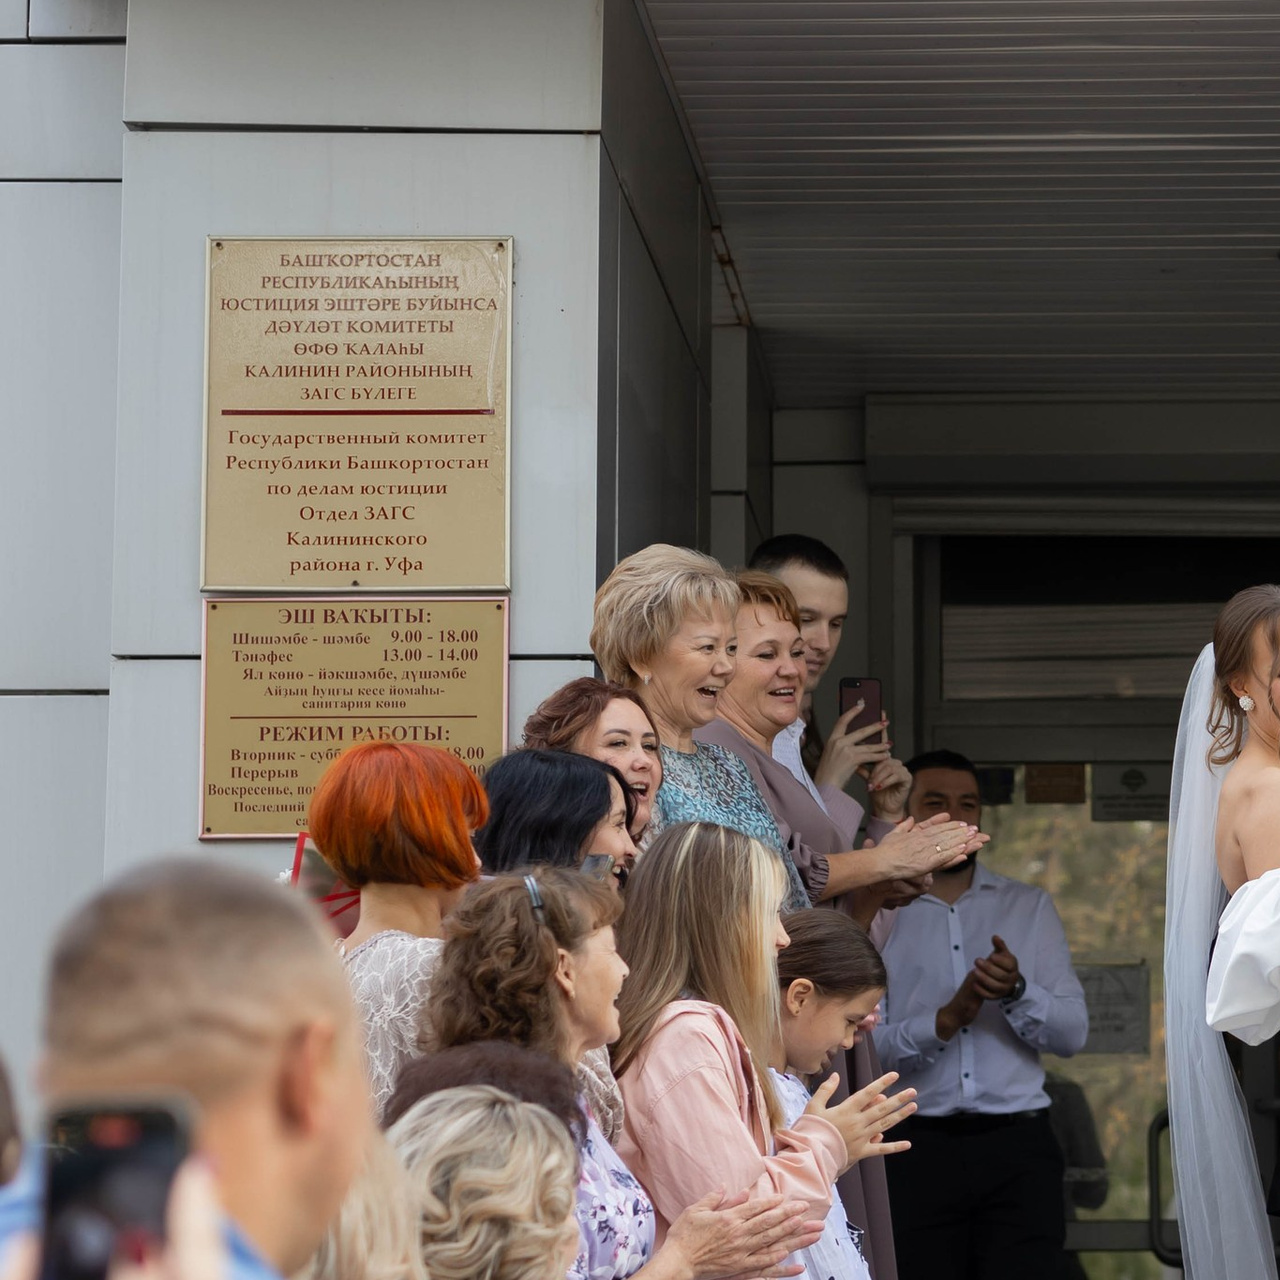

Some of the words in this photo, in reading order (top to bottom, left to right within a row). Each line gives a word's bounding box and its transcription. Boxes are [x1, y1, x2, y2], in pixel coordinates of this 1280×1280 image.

[220, 298, 319, 313] ЮСТИЦИЯ
[324, 298, 401, 311] ЭШТӘРЕ
[406, 295, 497, 311] БУЙЫНСА
[346, 320, 454, 333] КОМИТЕТЫ
[294, 343, 338, 355] ӨФӨ
[245, 365, 340, 377] КАЛИНИН
[346, 362, 473, 378] РАЙОНЫНЫҢ
[300, 388, 345, 400] ЗАГС
[228, 430, 400, 449] Государственный
[406, 433, 487, 445] комитет
[226, 455, 341, 474] Республики
[347, 456, 489, 474] Башкортостан
[267, 485, 291, 495] по
[297, 485, 354, 497] делам
[360, 484, 448, 497] юстиции
[300, 506, 358, 522] Отдел
[364, 506, 415, 520] ЗАГС
[287, 532, 427, 546] Калининского
[290, 558, 360, 576] района
[366, 560, 379, 572] г.
[384, 557, 423, 576] Уфа
[279, 609, 315, 624] ЭШ
[233, 633, 308, 645] Шишәмбе
[323, 633, 370, 644] шәмбе
[391, 630, 422, 643] 9.00
[440, 629, 478, 643] 18.00
[232, 650, 293, 664] Тәнәфес
[384, 648, 422, 661] 13.00
[439, 648, 478, 661] 14.00
[243, 668, 263, 680] Ял
[358, 688, 385, 696] кесе
[302, 699, 372, 711] санитария
[259, 726, 344, 741] РЕЖИМ
[352, 725, 451, 741] РАБОТЫ:
[231, 749, 296, 763] Вторник
[231, 766, 298, 781] Перерыв
[208, 784, 293, 798] Воскресенье,
[234, 802, 304, 812] Последний
